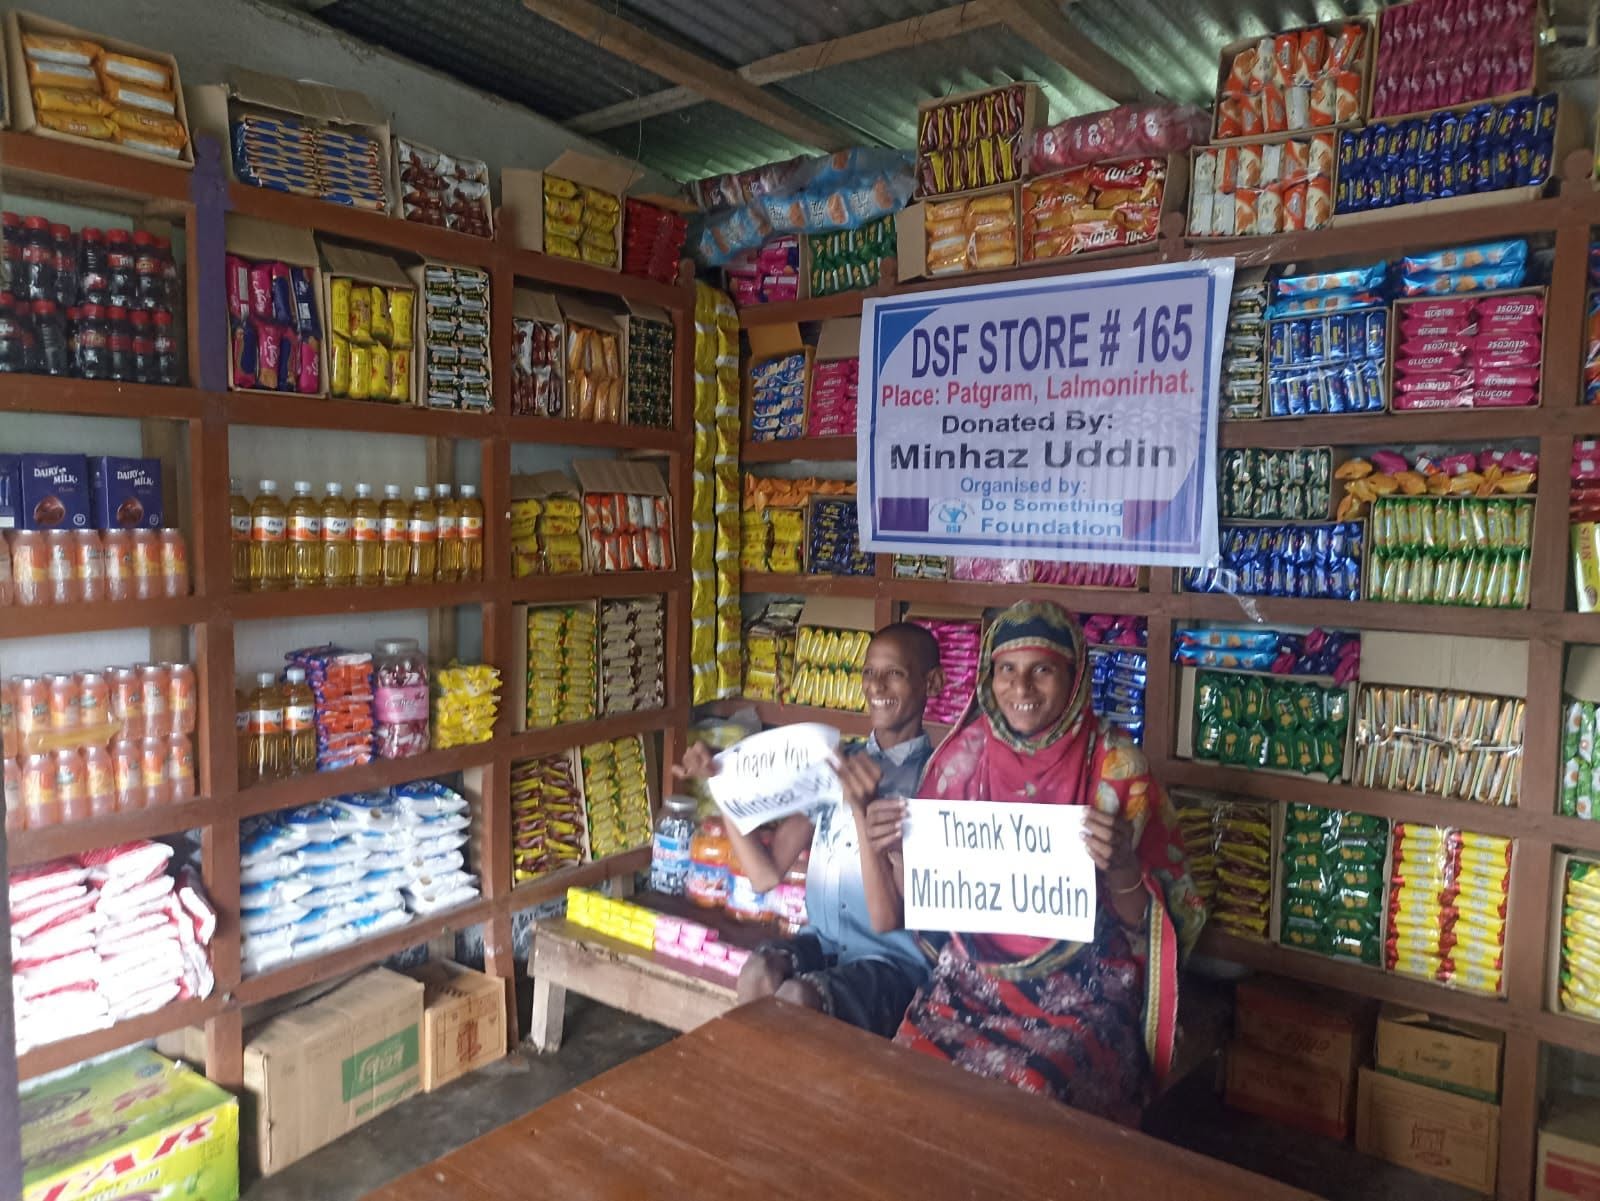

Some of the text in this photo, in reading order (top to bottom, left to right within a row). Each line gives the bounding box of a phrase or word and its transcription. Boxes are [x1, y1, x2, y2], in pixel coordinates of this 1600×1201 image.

[912, 304, 1193, 379] DSF STORE # 165
[1408, 357, 1444, 366] GLUCOSE
[881, 368, 1195, 410] Place: Patgram, Lalmonirhat.
[1475, 389, 1513, 398] GLUCOSE
[941, 409, 1114, 436] Donated By:
[890, 438, 1177, 471] Minhaz Uddin
[34, 466, 59, 477] DAIRY
[960, 476, 1087, 497] Organised by:
[981, 499, 1007, 511] Do
[1013, 499, 1124, 517] Something
[981, 518, 1122, 537] Foundation
[938, 810, 1052, 853] Thank You
[911, 867, 1089, 918] Minhaz Uddin
